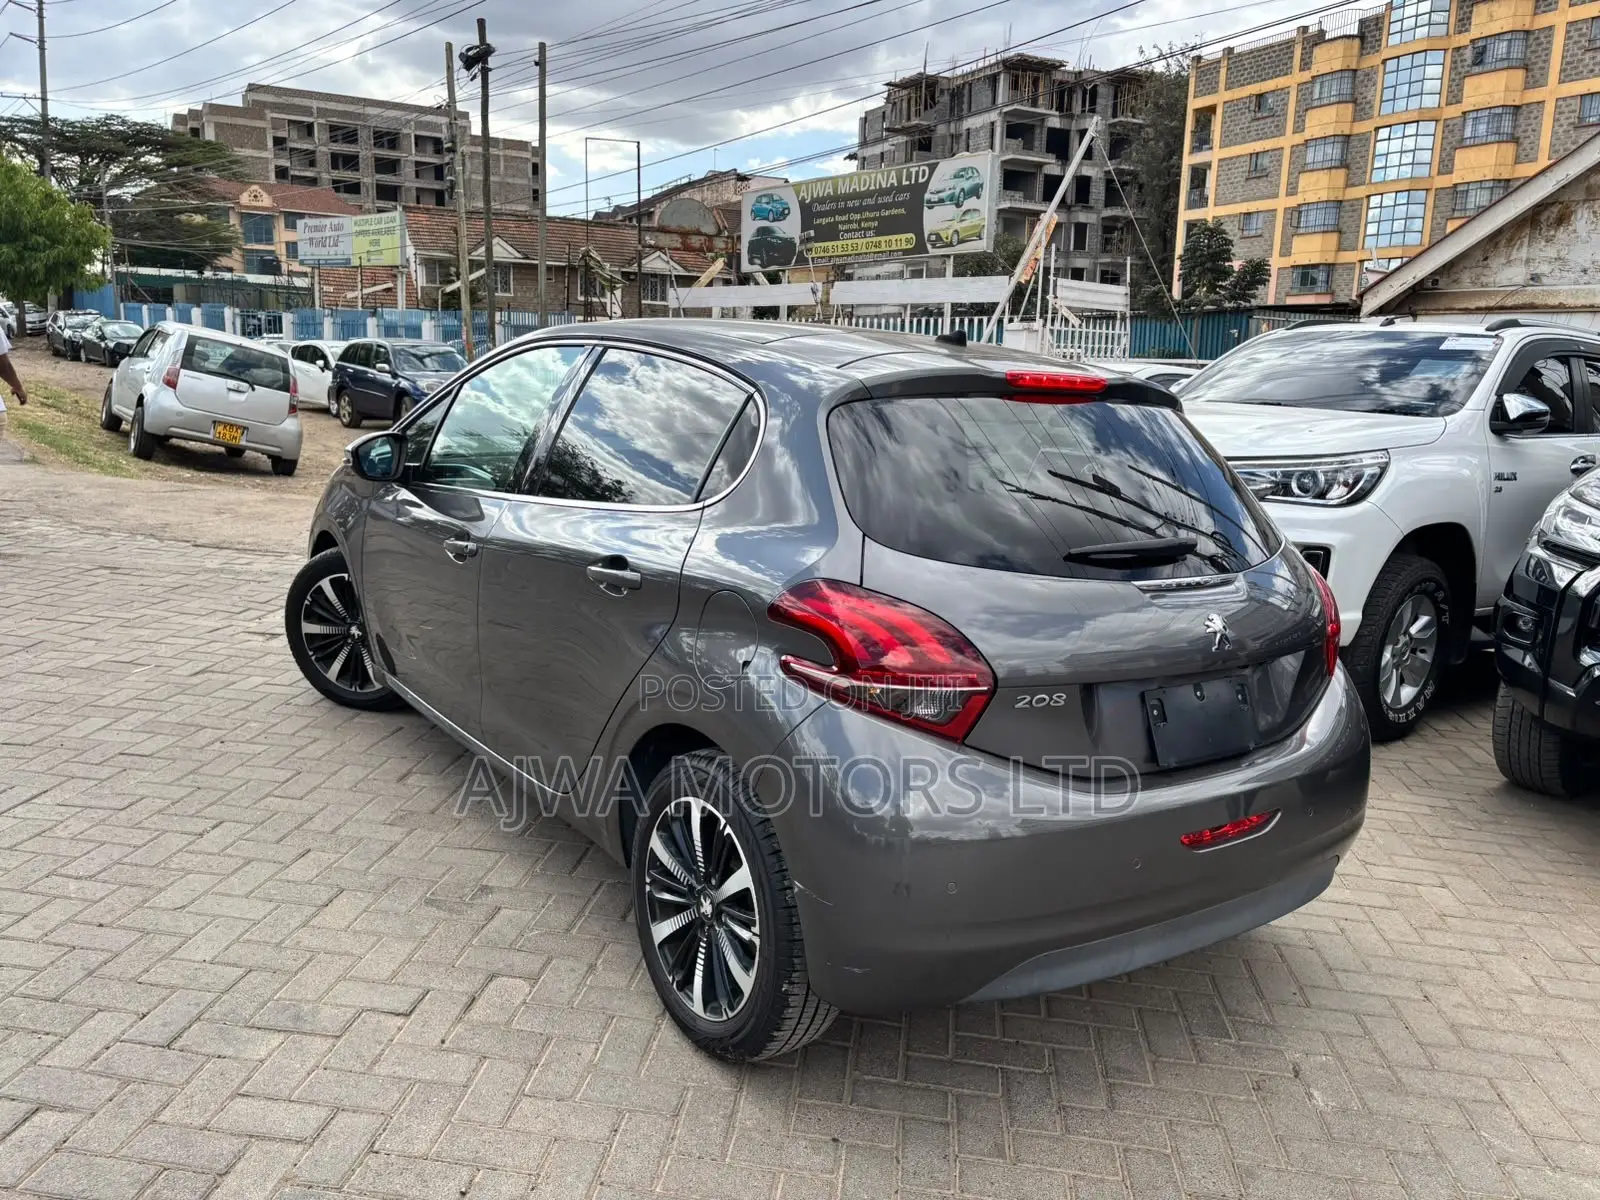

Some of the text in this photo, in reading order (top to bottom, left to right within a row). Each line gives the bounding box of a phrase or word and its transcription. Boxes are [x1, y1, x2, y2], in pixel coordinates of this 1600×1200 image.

[799, 166, 929, 203] AJWA MADINA LTD
[812, 191, 910, 212] Dealers in new and used cars
[813, 215, 834, 225] Langata
[835, 213, 849, 222] Road
[861, 221, 879, 229] Kenya
[303, 220, 345, 234] Premier Auto
[308, 235, 340, 248] World Ltd
[839, 230, 876, 240] Contact us:
[814, 246, 830, 255] 0746
[831, 244, 839, 253] 51
[840, 243, 849, 252] 53
[850, 242, 859, 252] 53
[865, 240, 882, 250] 0748
[884, 239, 893, 249] 10
[894, 238, 903, 247] 11
[904, 236, 914, 246] 90
[222, 423, 242, 434] KBX
[216, 431, 240, 444] 183M
[1493, 471, 1518, 481] HILUX
[1014, 693, 1067, 708] 208
